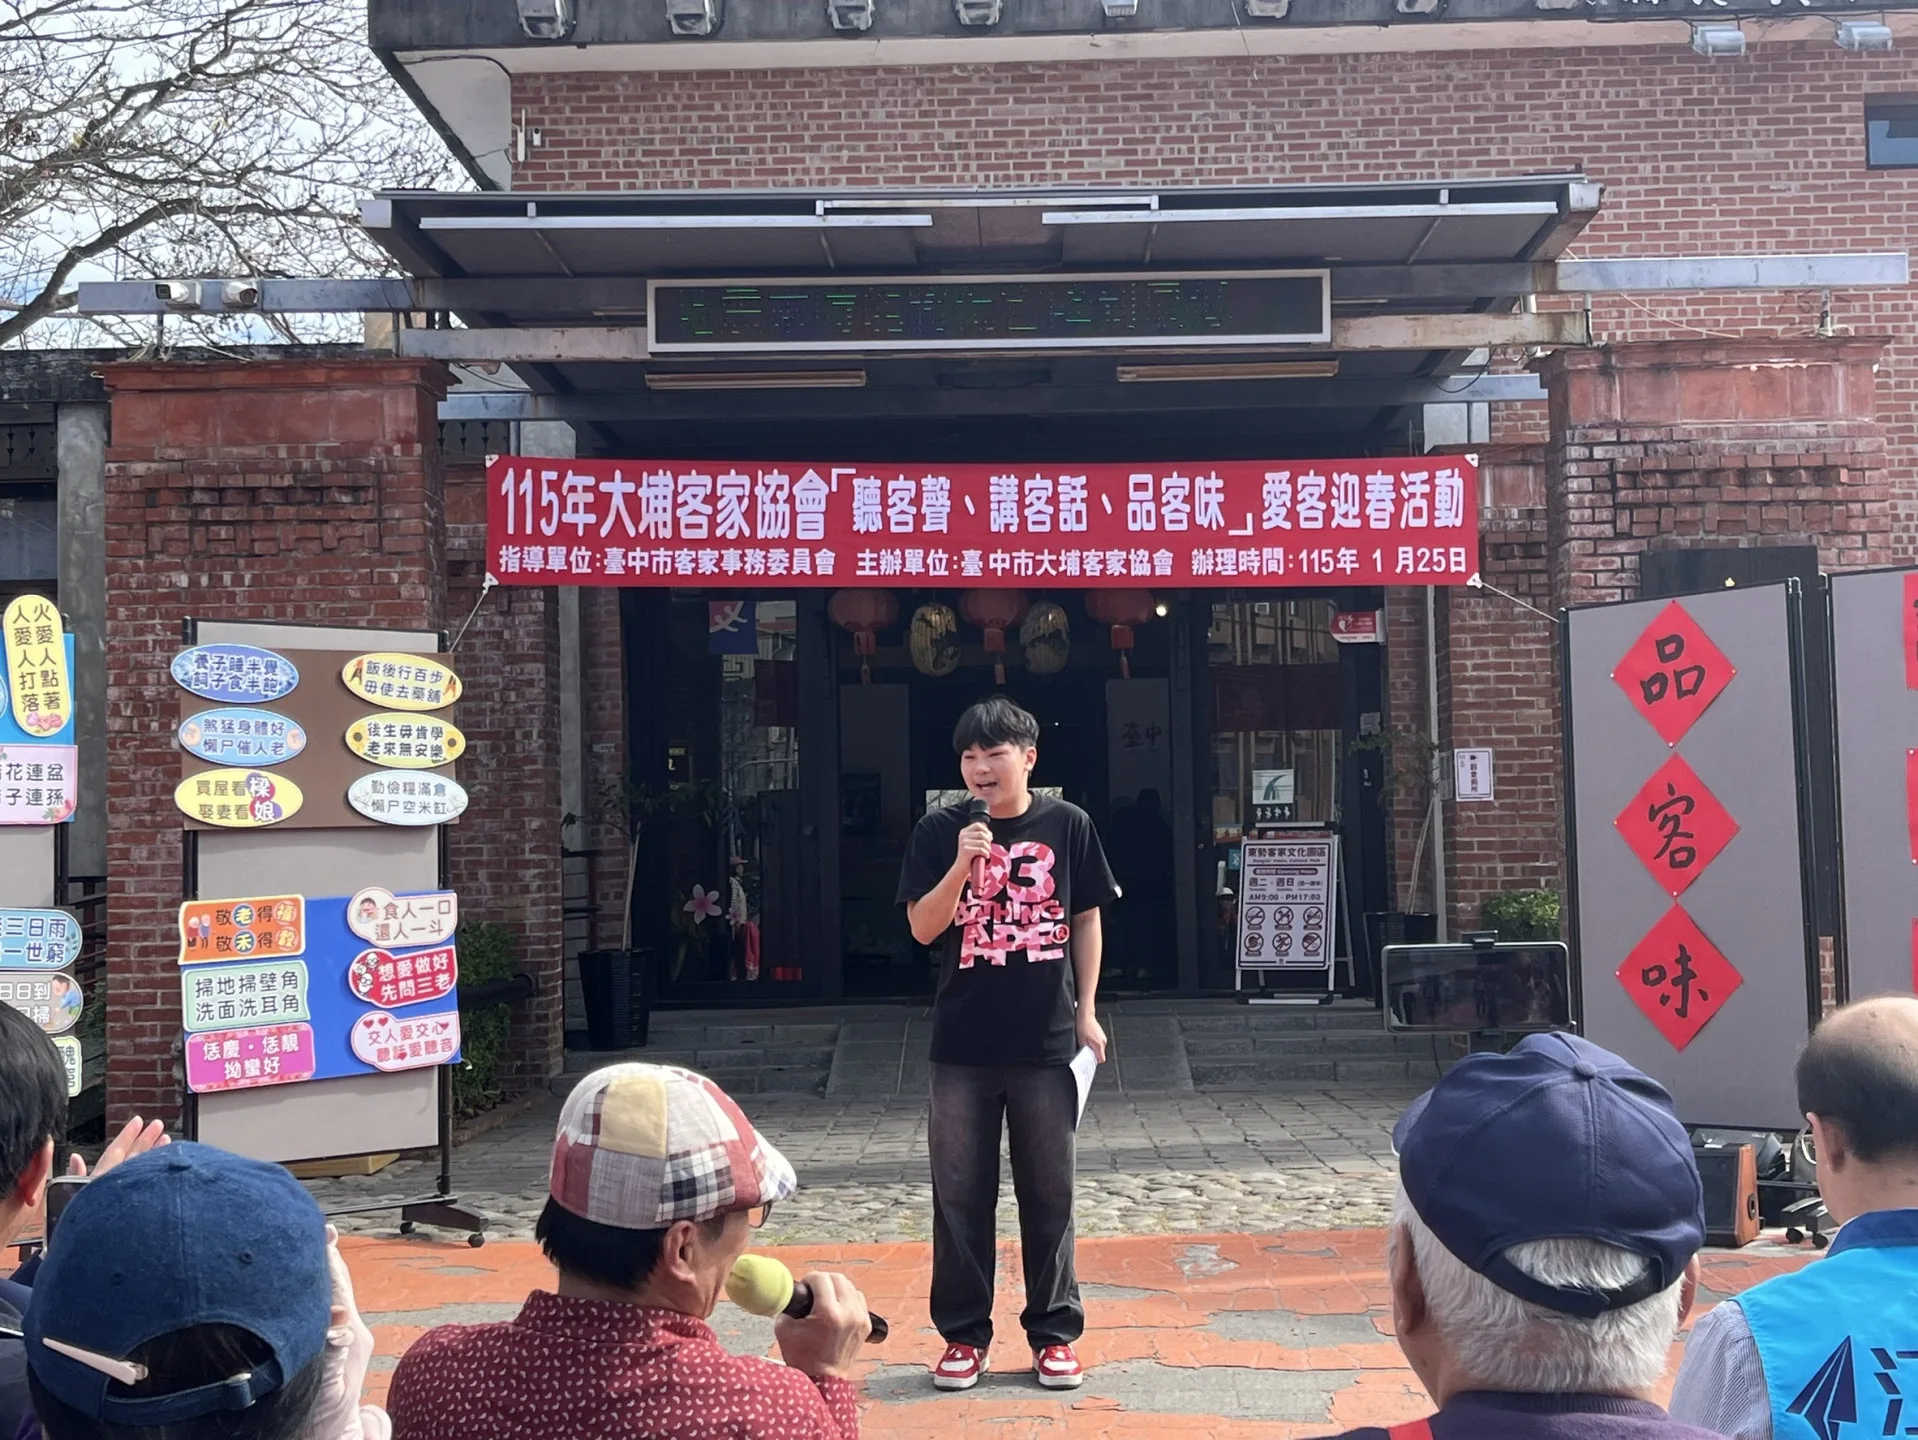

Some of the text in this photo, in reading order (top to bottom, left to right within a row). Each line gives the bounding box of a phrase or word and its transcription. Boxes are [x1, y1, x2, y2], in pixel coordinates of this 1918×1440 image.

[366, 660, 444, 685] 飯後行百步
[203, 718, 285, 736] 煞猛身體好
[367, 740, 444, 759] 老來無安樂
[0, 763, 64, 783] 花連盆
[0, 787, 64, 808] 子連孫
[198, 800, 276, 823] 娶妻看娘
[215, 902, 296, 926] 敬老得福
[383, 900, 451, 921] 食人一口
[0, 916, 67, 939] 三日雨
[375, 918, 444, 942] 還人一斗
[378, 952, 449, 982] 想愛做好
[195, 970, 299, 999] 掃地掃壁角
[380, 972, 451, 1003] 先問三老
[195, 993, 300, 1022] 洗面洗耳角
